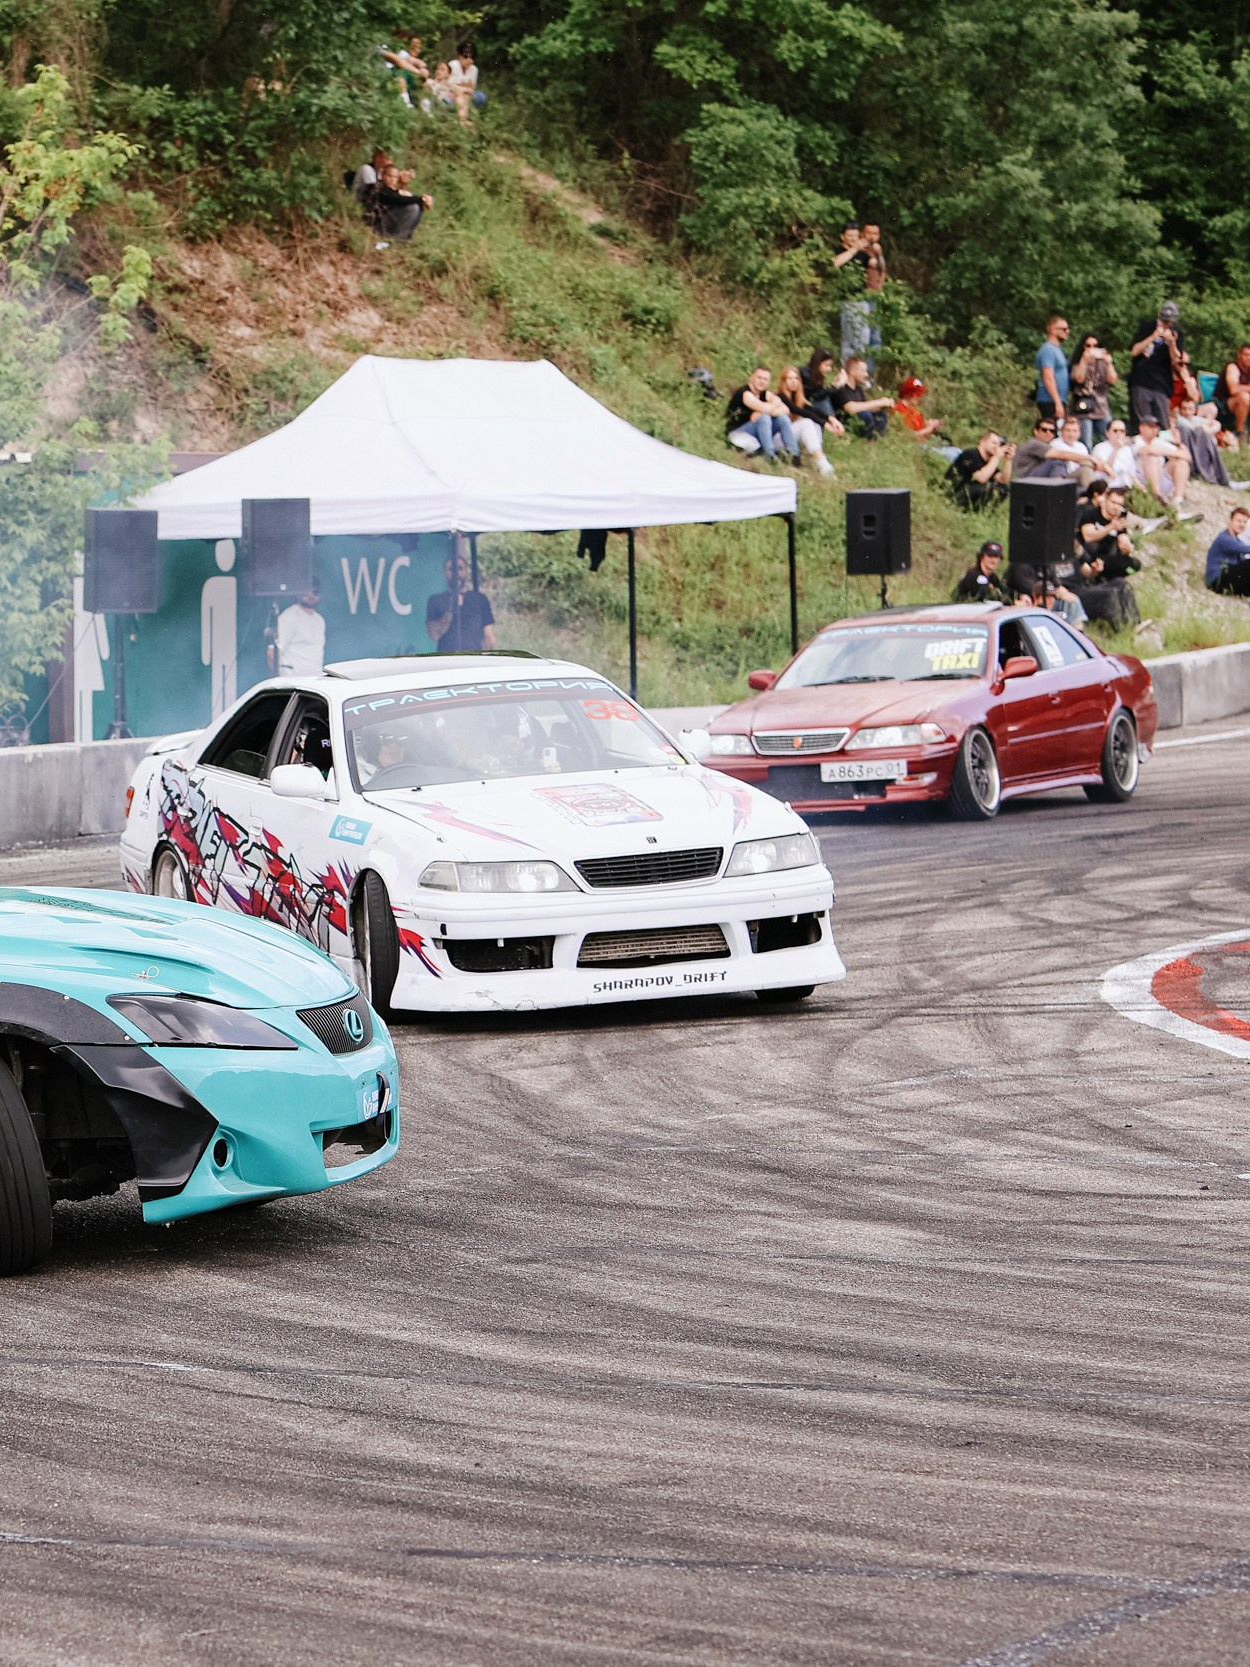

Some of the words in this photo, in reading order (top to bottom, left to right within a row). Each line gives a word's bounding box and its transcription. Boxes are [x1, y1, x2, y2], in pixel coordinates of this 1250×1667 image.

[341, 556, 412, 616] WC
[924, 638, 986, 659] DRIFT
[931, 653, 980, 672] TAXI
[582, 699, 639, 721] 38
